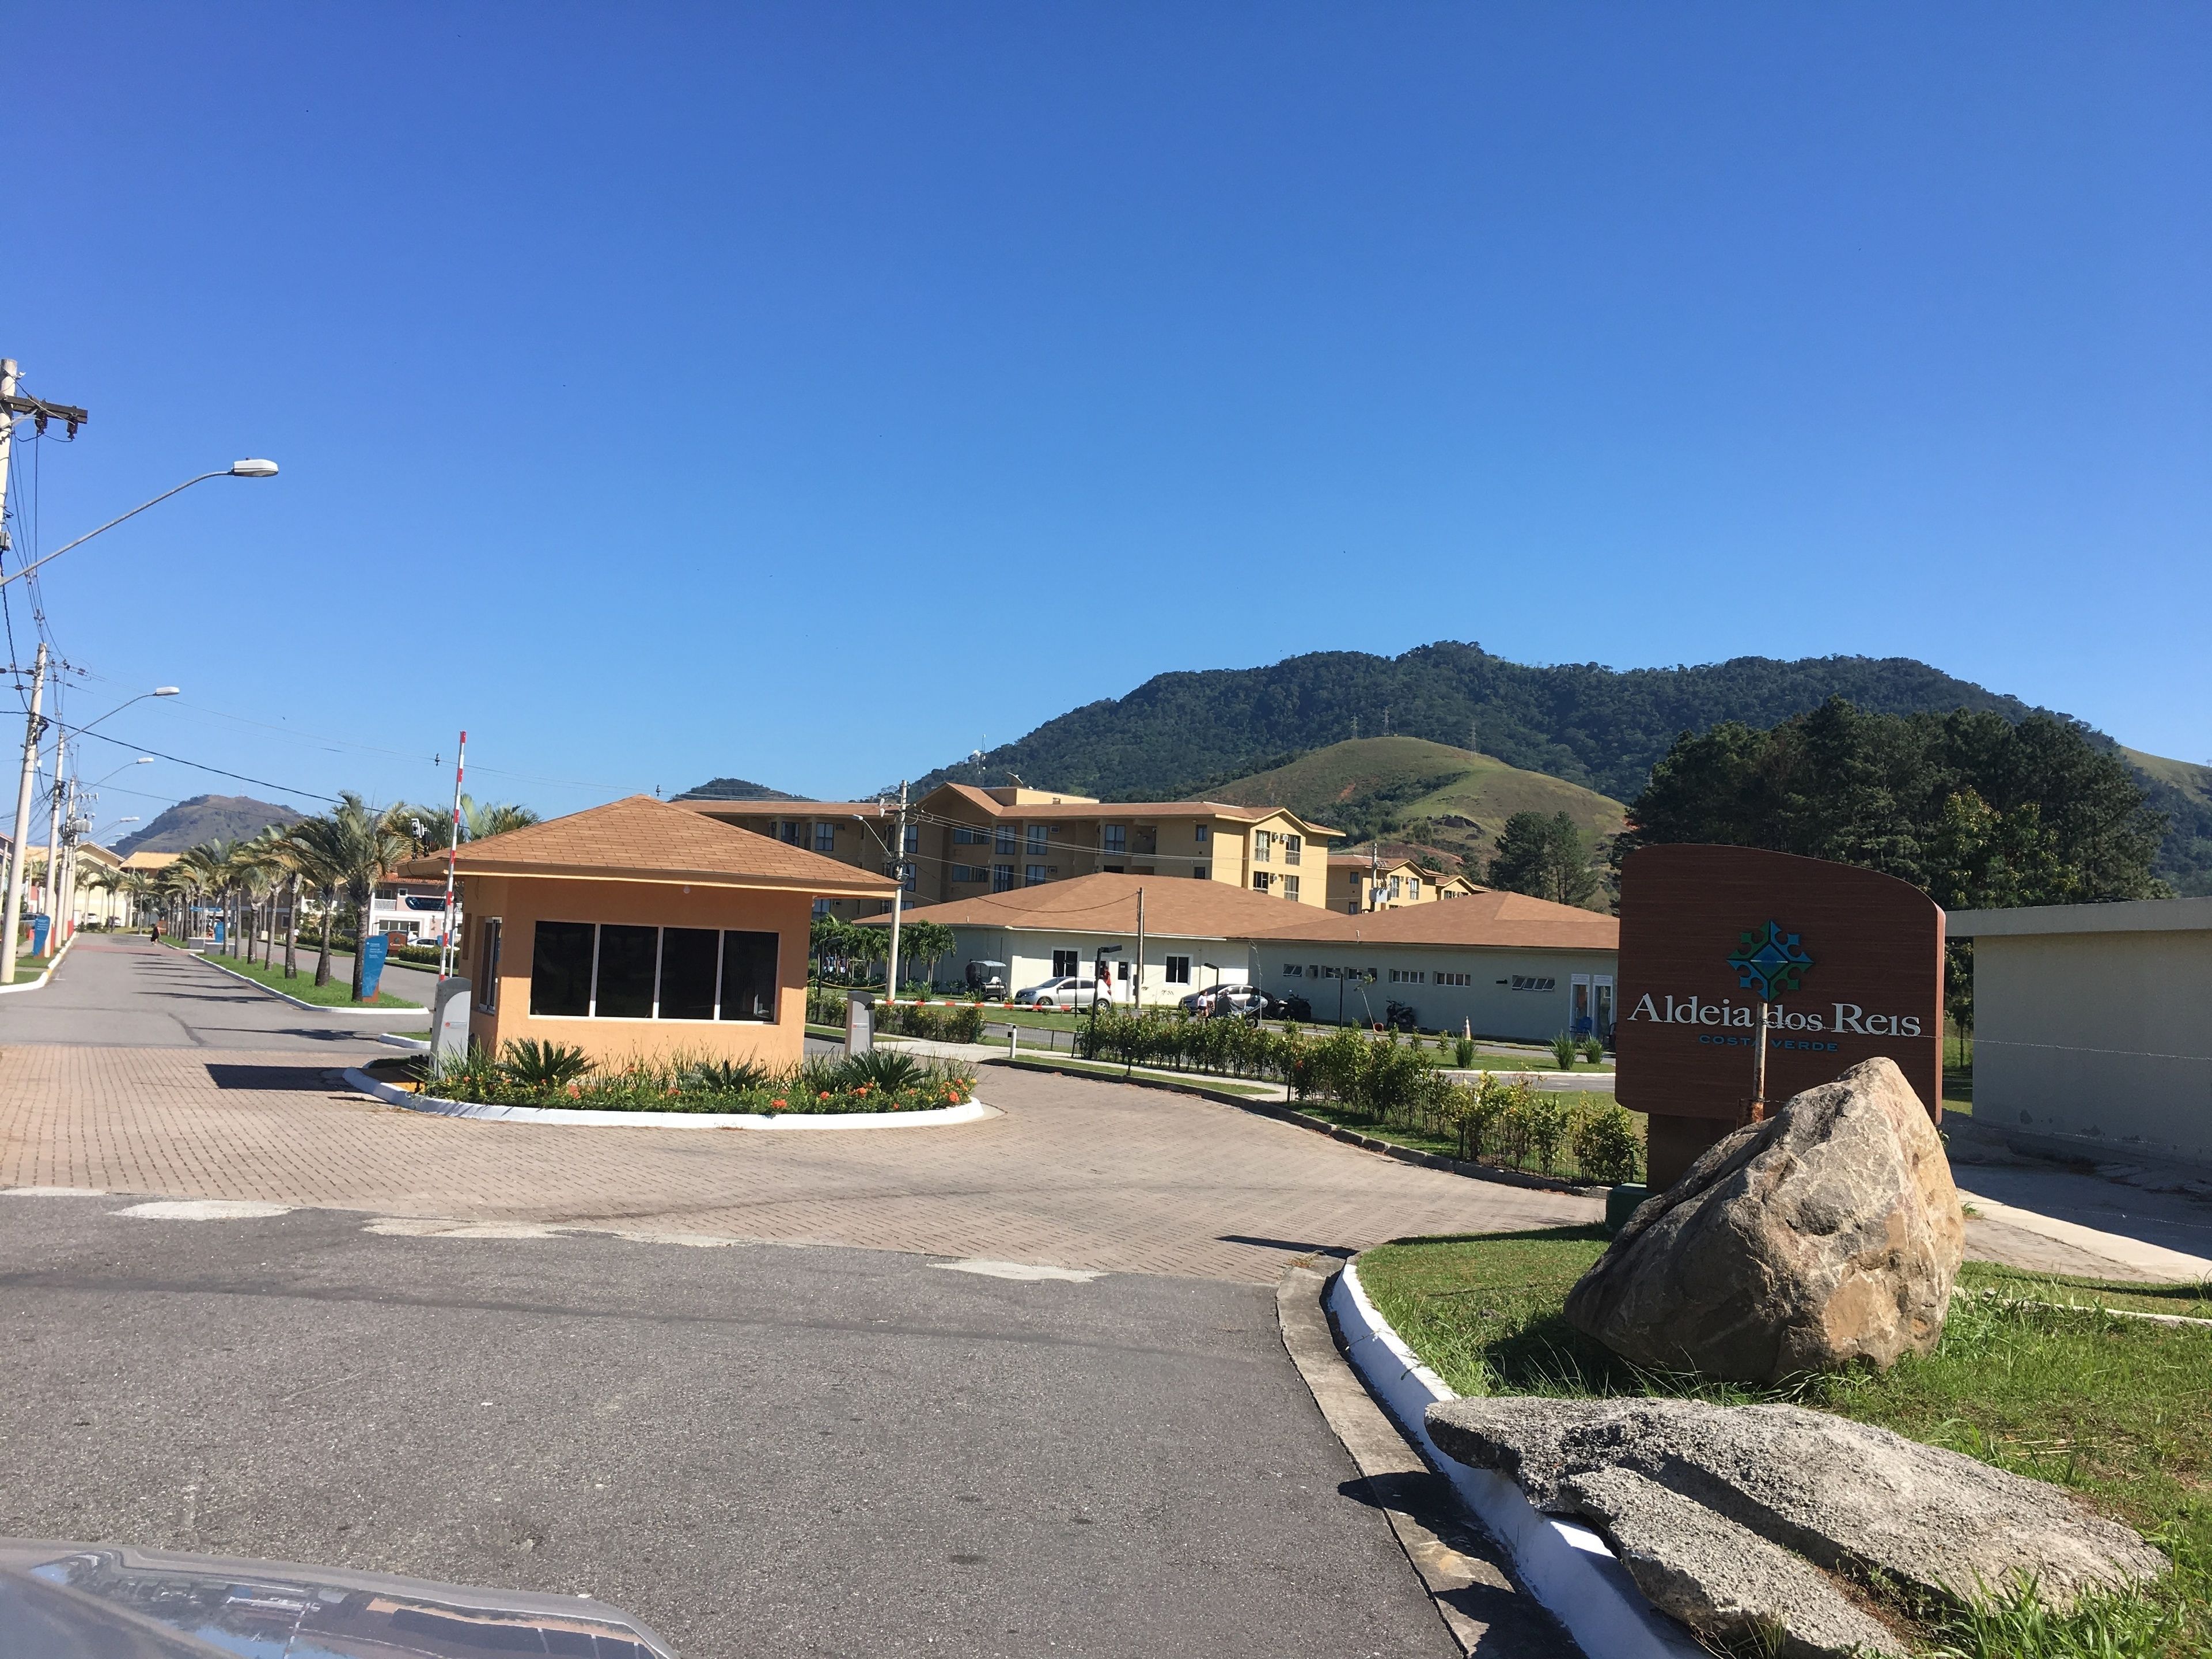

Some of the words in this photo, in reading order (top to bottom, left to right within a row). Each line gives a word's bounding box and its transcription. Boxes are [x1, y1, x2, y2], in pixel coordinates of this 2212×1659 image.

[1627, 993, 1755, 1028] Aldeia
[1766, 1004, 1824, 1032] dos
[1831, 1002, 1921, 1037] Reis
[1771, 1039, 1838, 1052] VERDE
